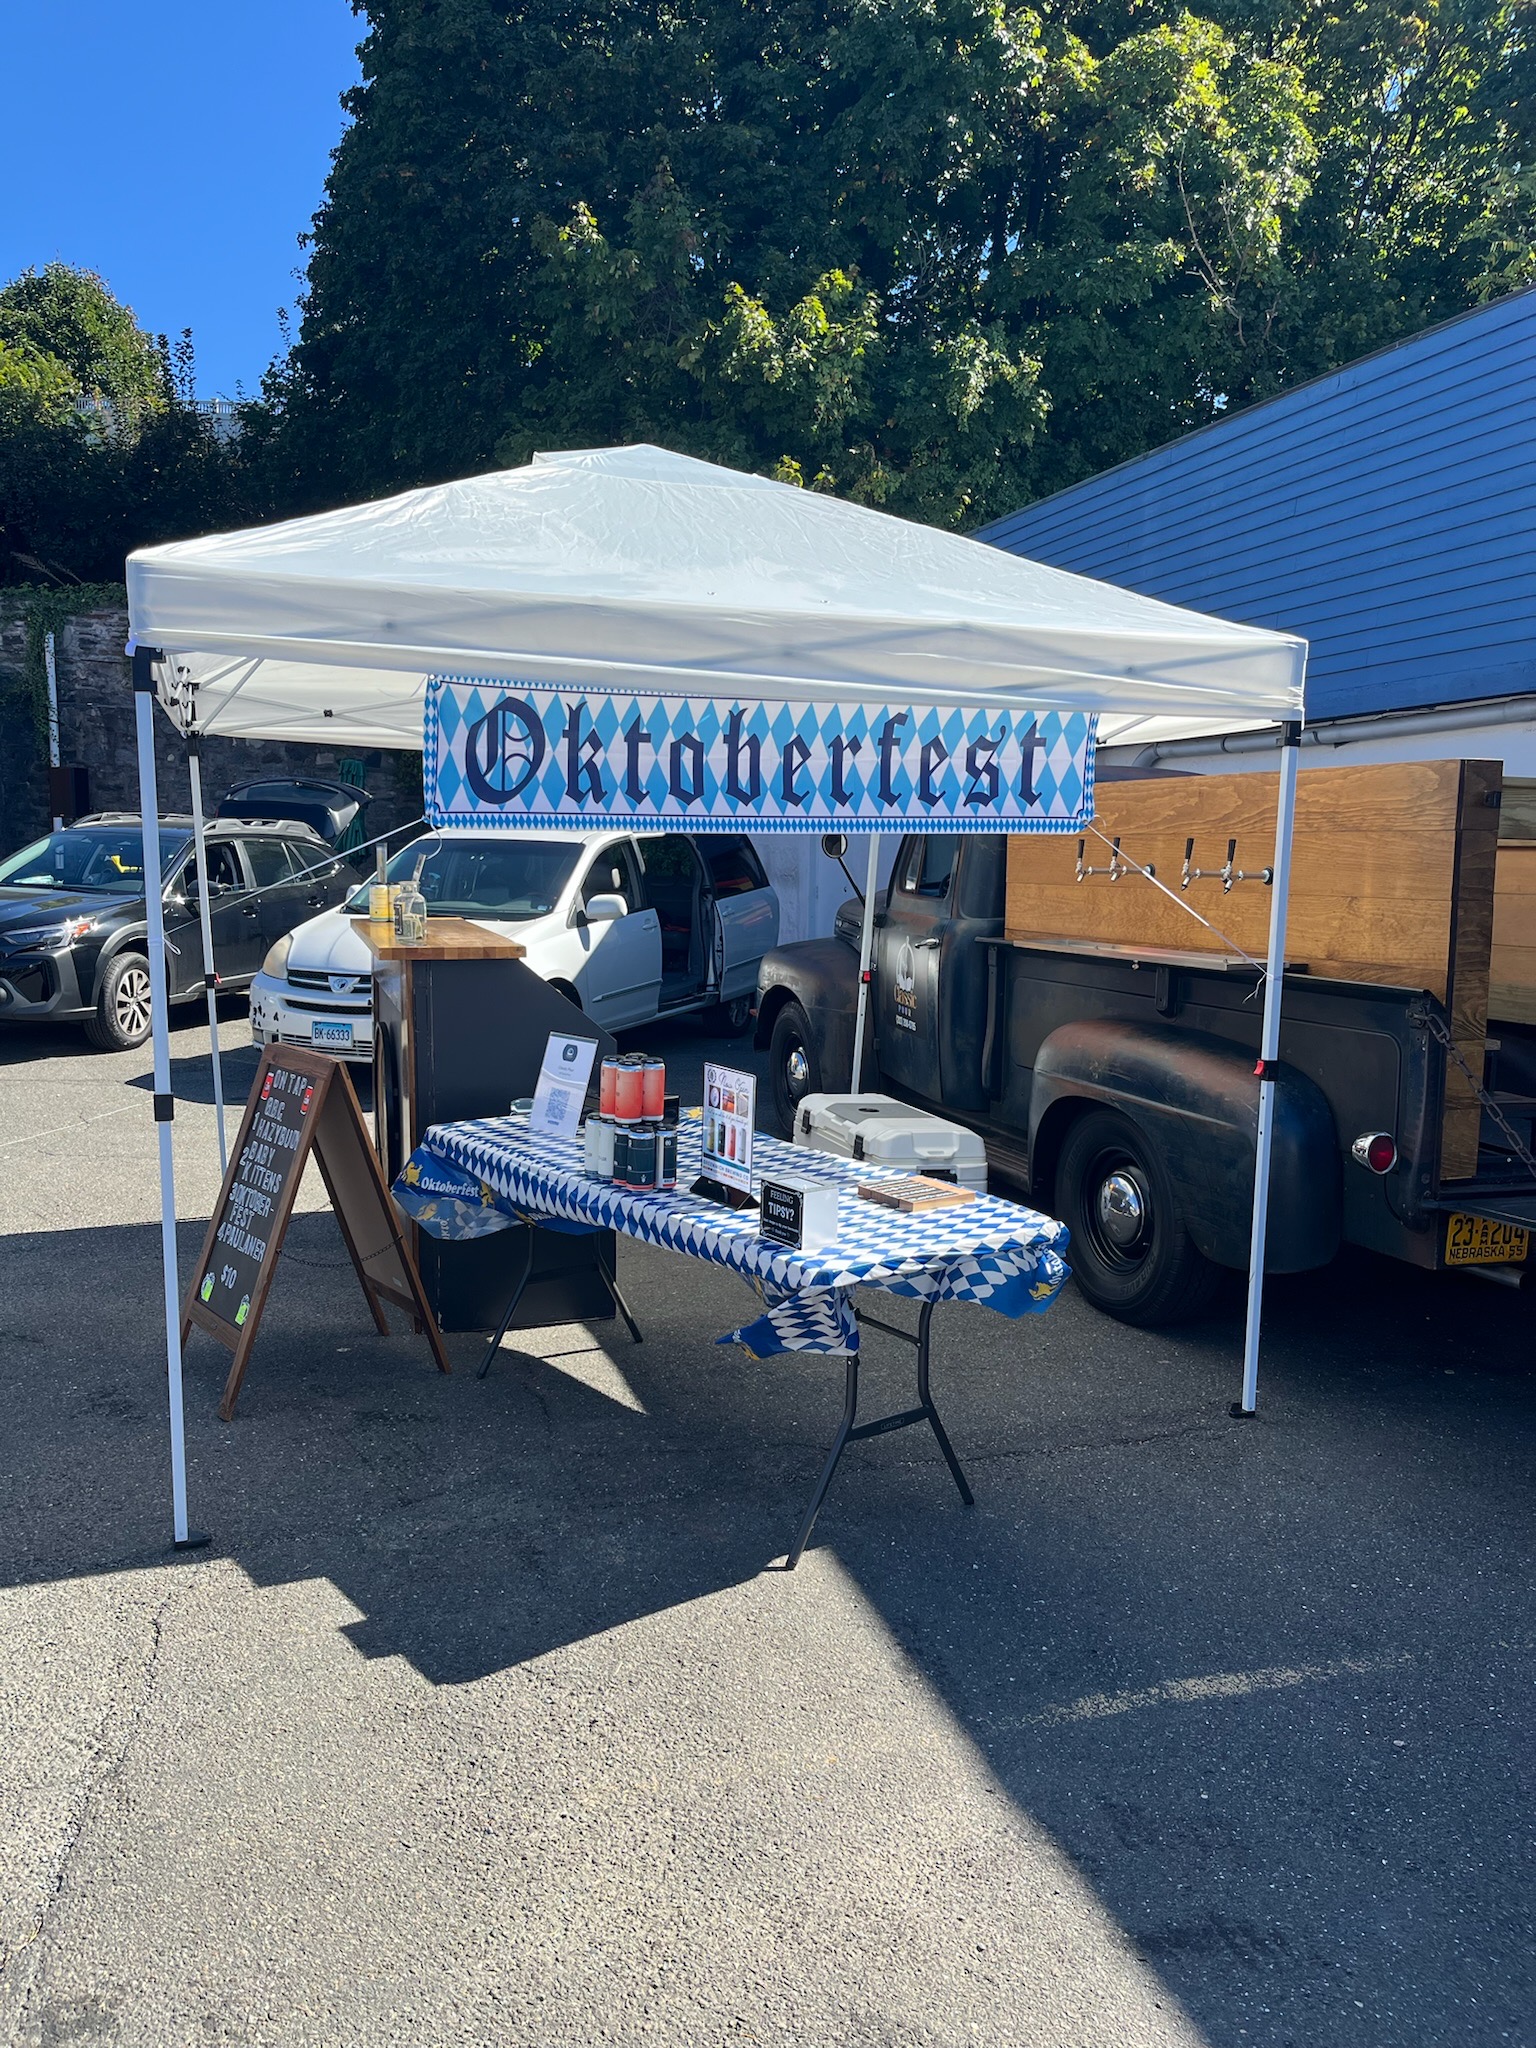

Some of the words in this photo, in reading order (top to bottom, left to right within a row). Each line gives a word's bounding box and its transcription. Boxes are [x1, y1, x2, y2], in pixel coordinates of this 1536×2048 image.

[465, 696, 1047, 807] Oktoberfest
[273, 1069, 288, 1091] ON
[287, 1073, 308, 1097] TAP
[248, 1141, 276, 1167] BABY
[241, 1162, 282, 1194] KITTENS
[421, 1176, 479, 1197] Oktoberfest
[770, 1189, 793, 1204] FEELING
[229, 1202, 255, 1230] FEST
[768, 1202, 795, 1221] TIPSY?
[1449, 1245, 1505, 1259] NEBRASKA
[221, 1264, 237, 1289] $10
